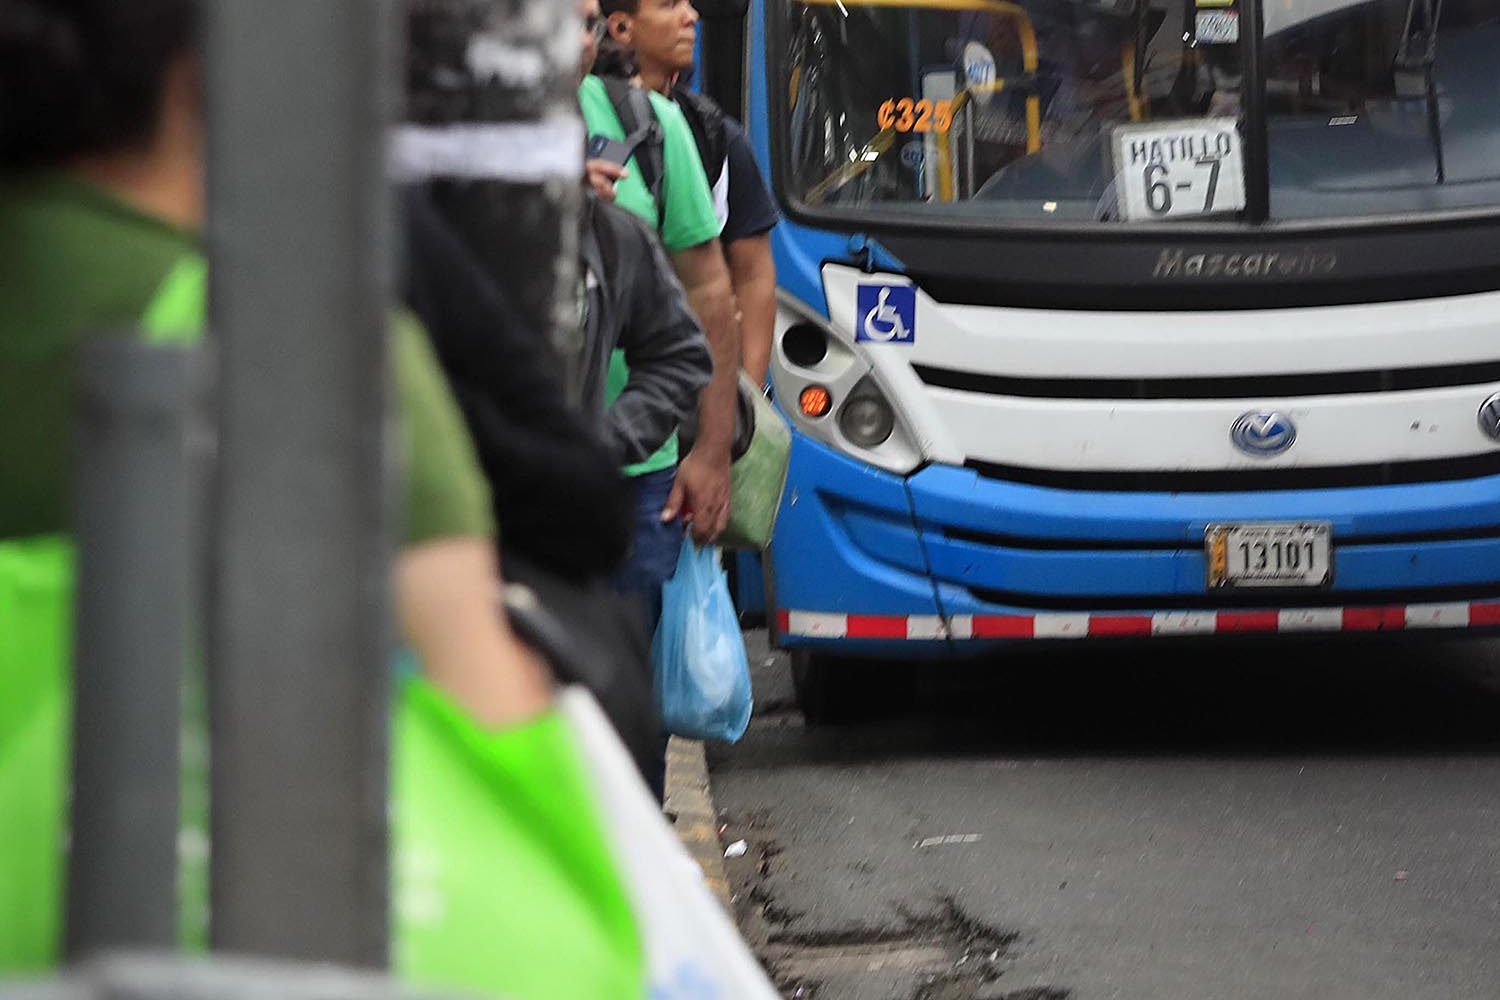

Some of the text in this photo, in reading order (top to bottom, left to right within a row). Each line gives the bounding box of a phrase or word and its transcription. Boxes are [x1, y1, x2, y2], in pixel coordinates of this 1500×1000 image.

[1131, 132, 1231, 163] HATILLO
[1144, 158, 1220, 216] 6-7
[1239, 541, 1313, 571] 13101
